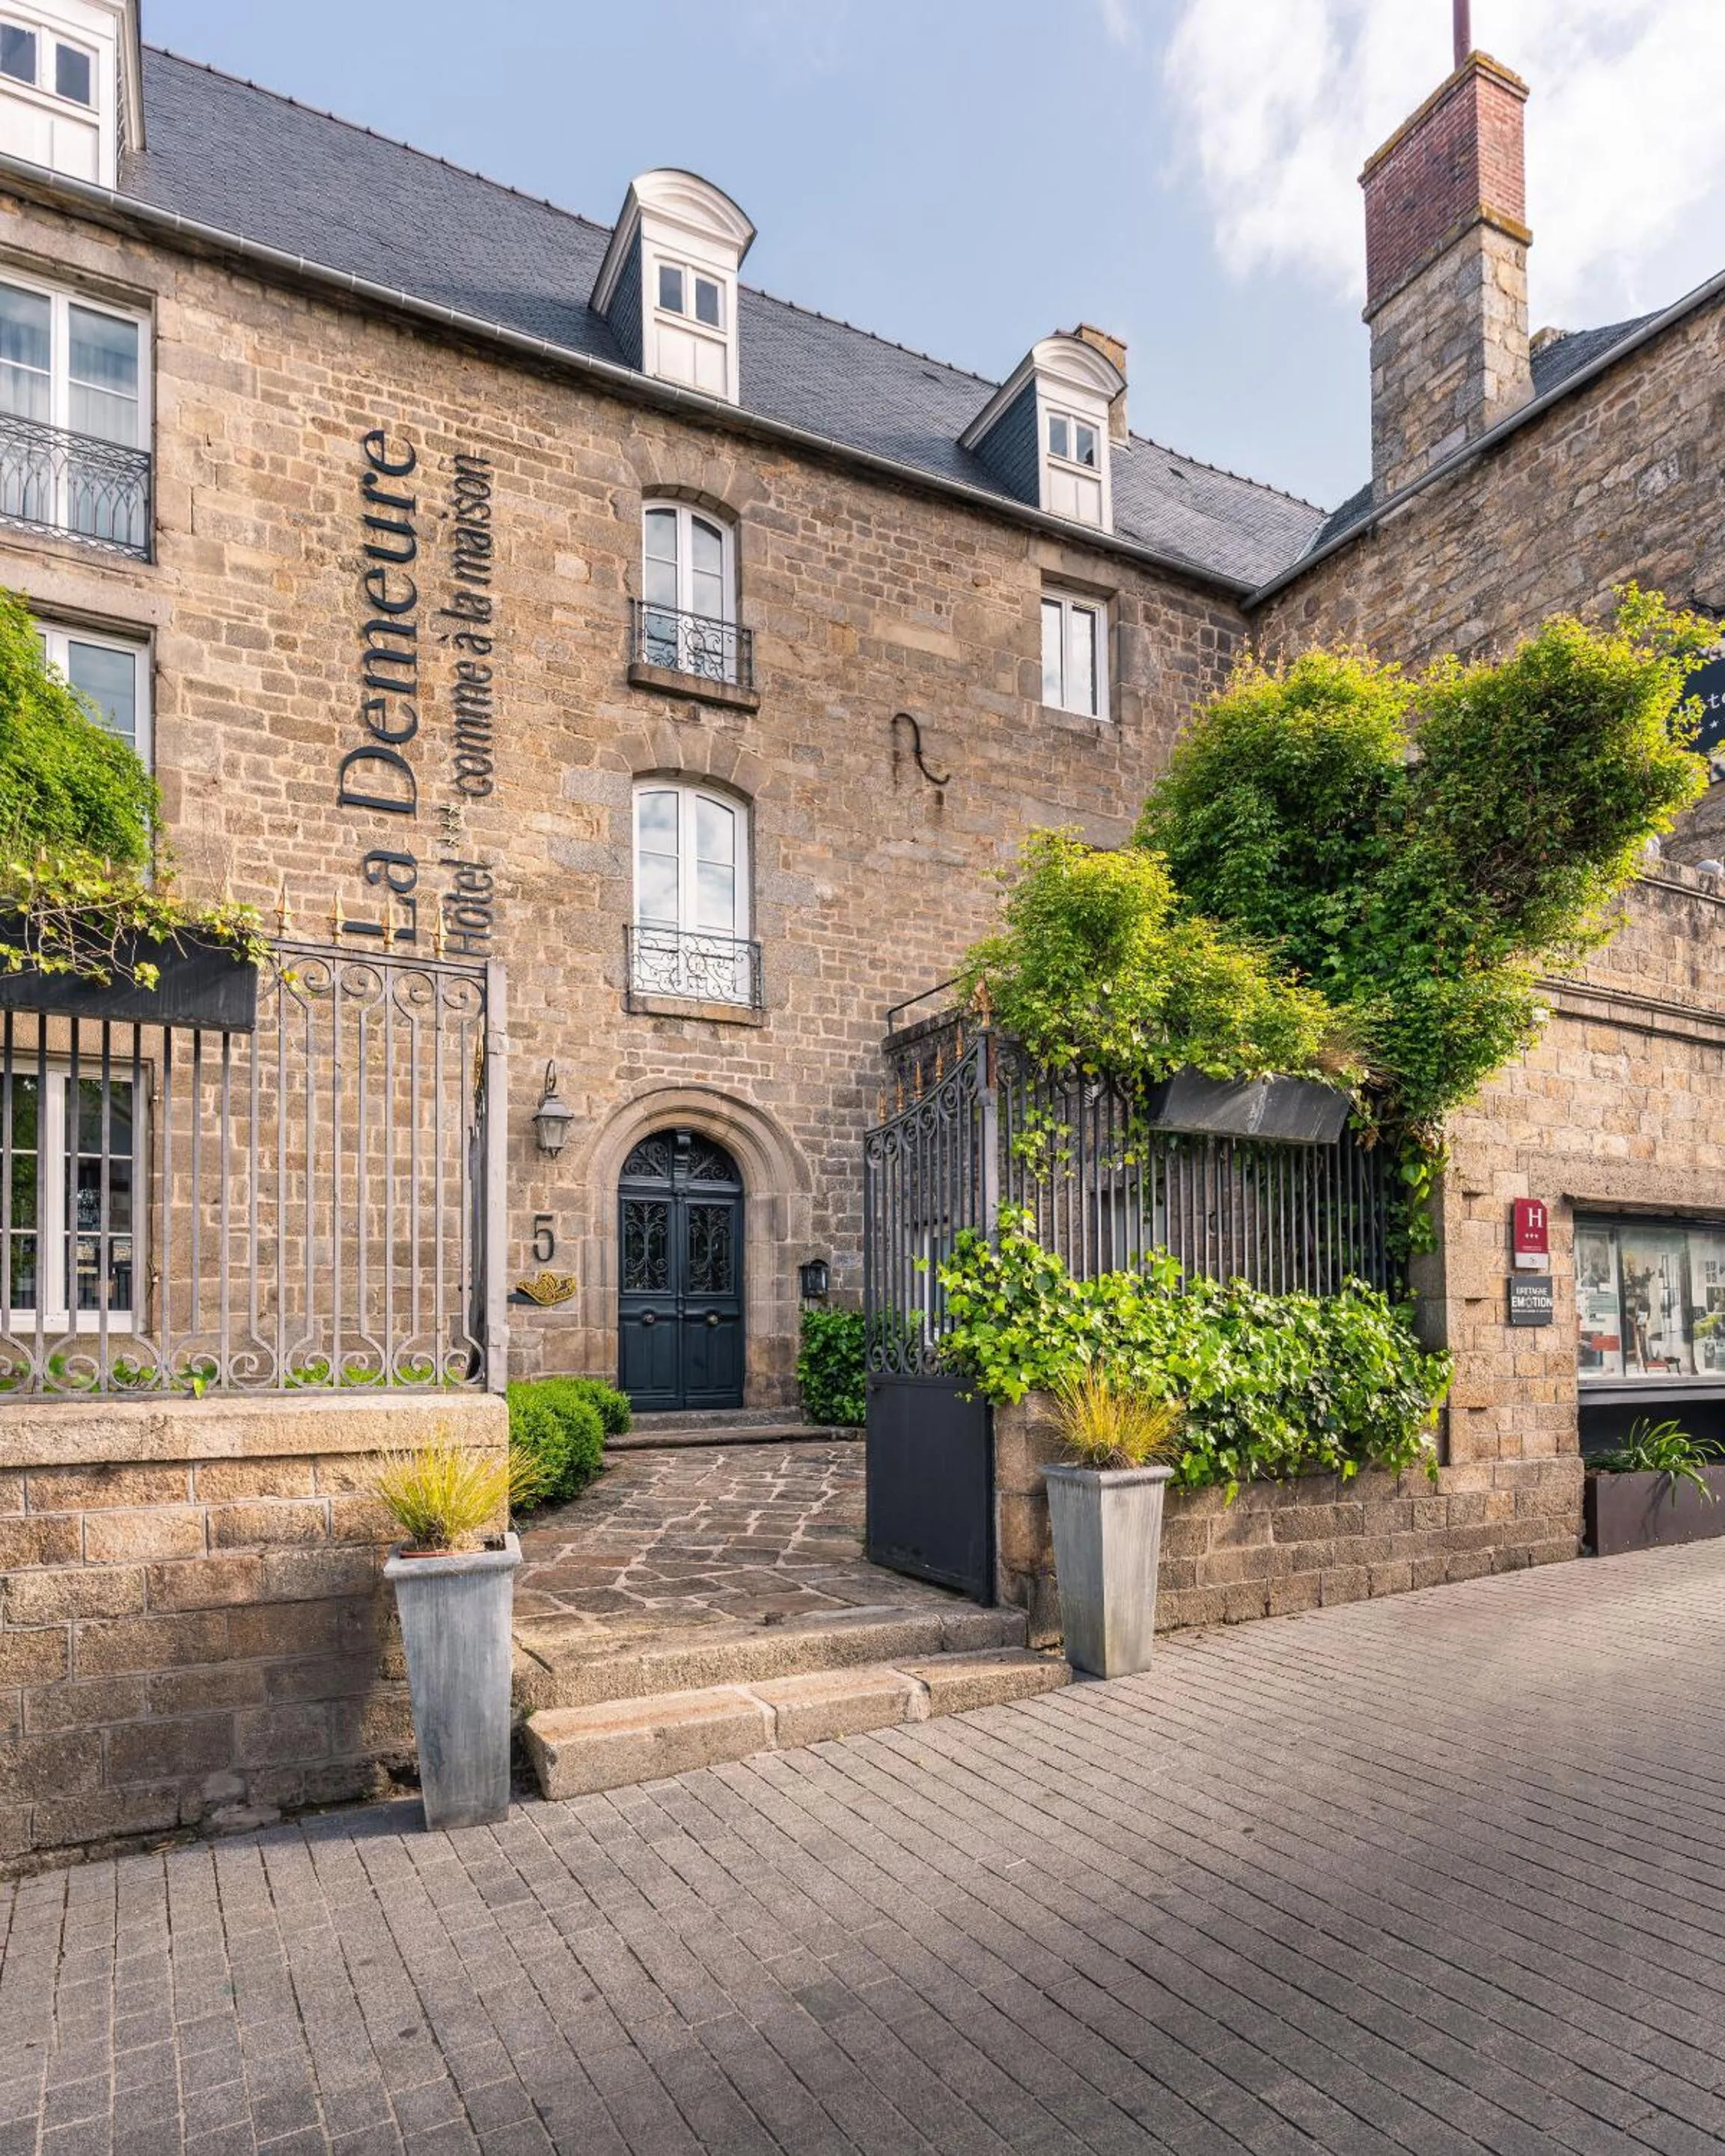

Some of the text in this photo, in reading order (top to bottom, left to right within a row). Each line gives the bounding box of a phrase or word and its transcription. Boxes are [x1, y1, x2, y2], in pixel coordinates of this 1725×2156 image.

[338, 430, 418, 946] La Demeure
[438, 454, 494, 957] Hôtel comme à la maison
[533, 1215, 555, 1262] 5
[1528, 1207, 1544, 1228] H
